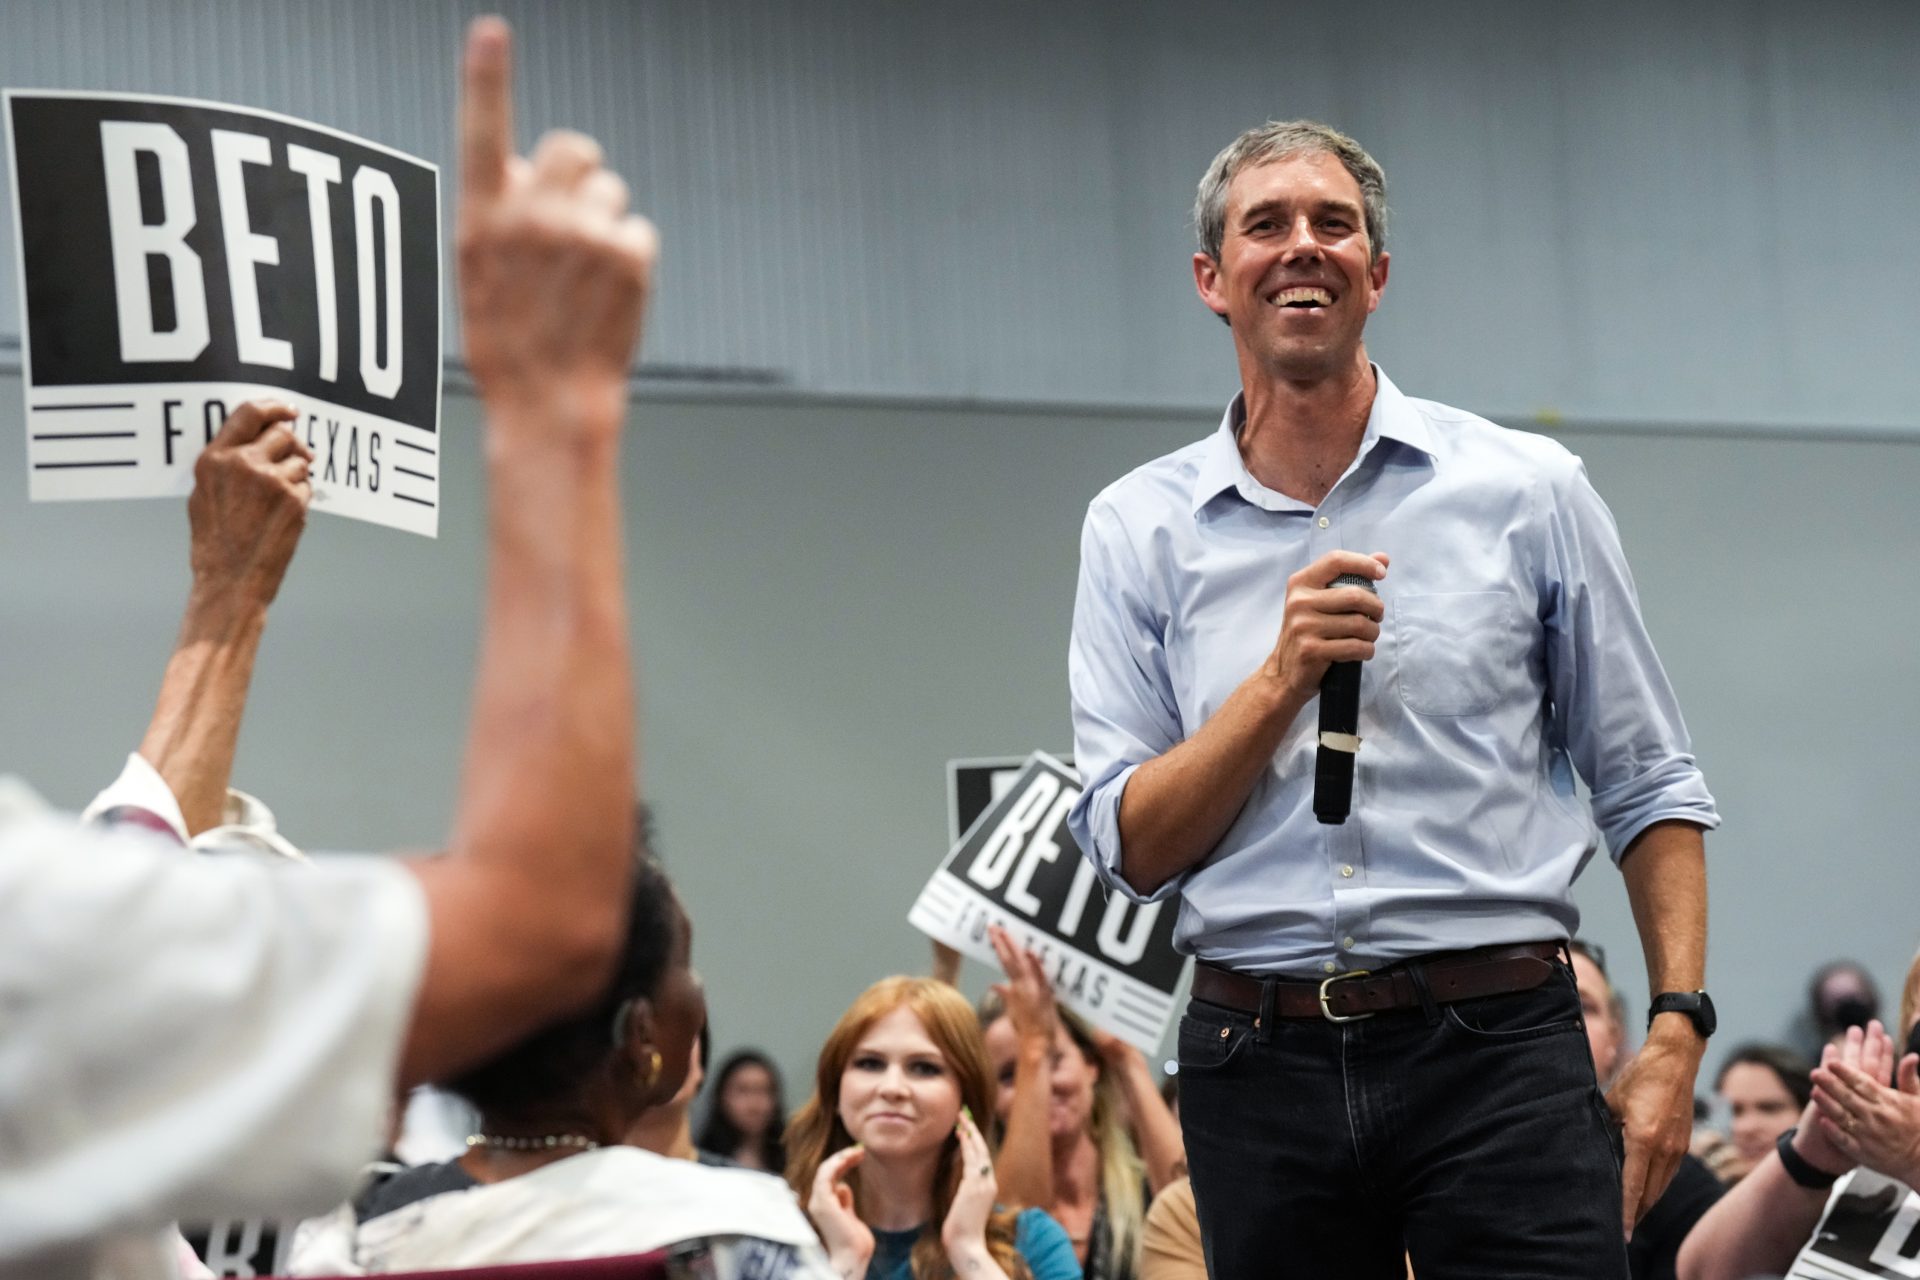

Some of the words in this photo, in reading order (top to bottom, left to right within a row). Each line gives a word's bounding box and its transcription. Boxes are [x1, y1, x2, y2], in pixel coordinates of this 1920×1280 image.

[100, 120, 402, 400] BETO
[163, 400, 227, 466] FO
[292, 413, 382, 493] EXAS
[955, 900, 1006, 949] FO
